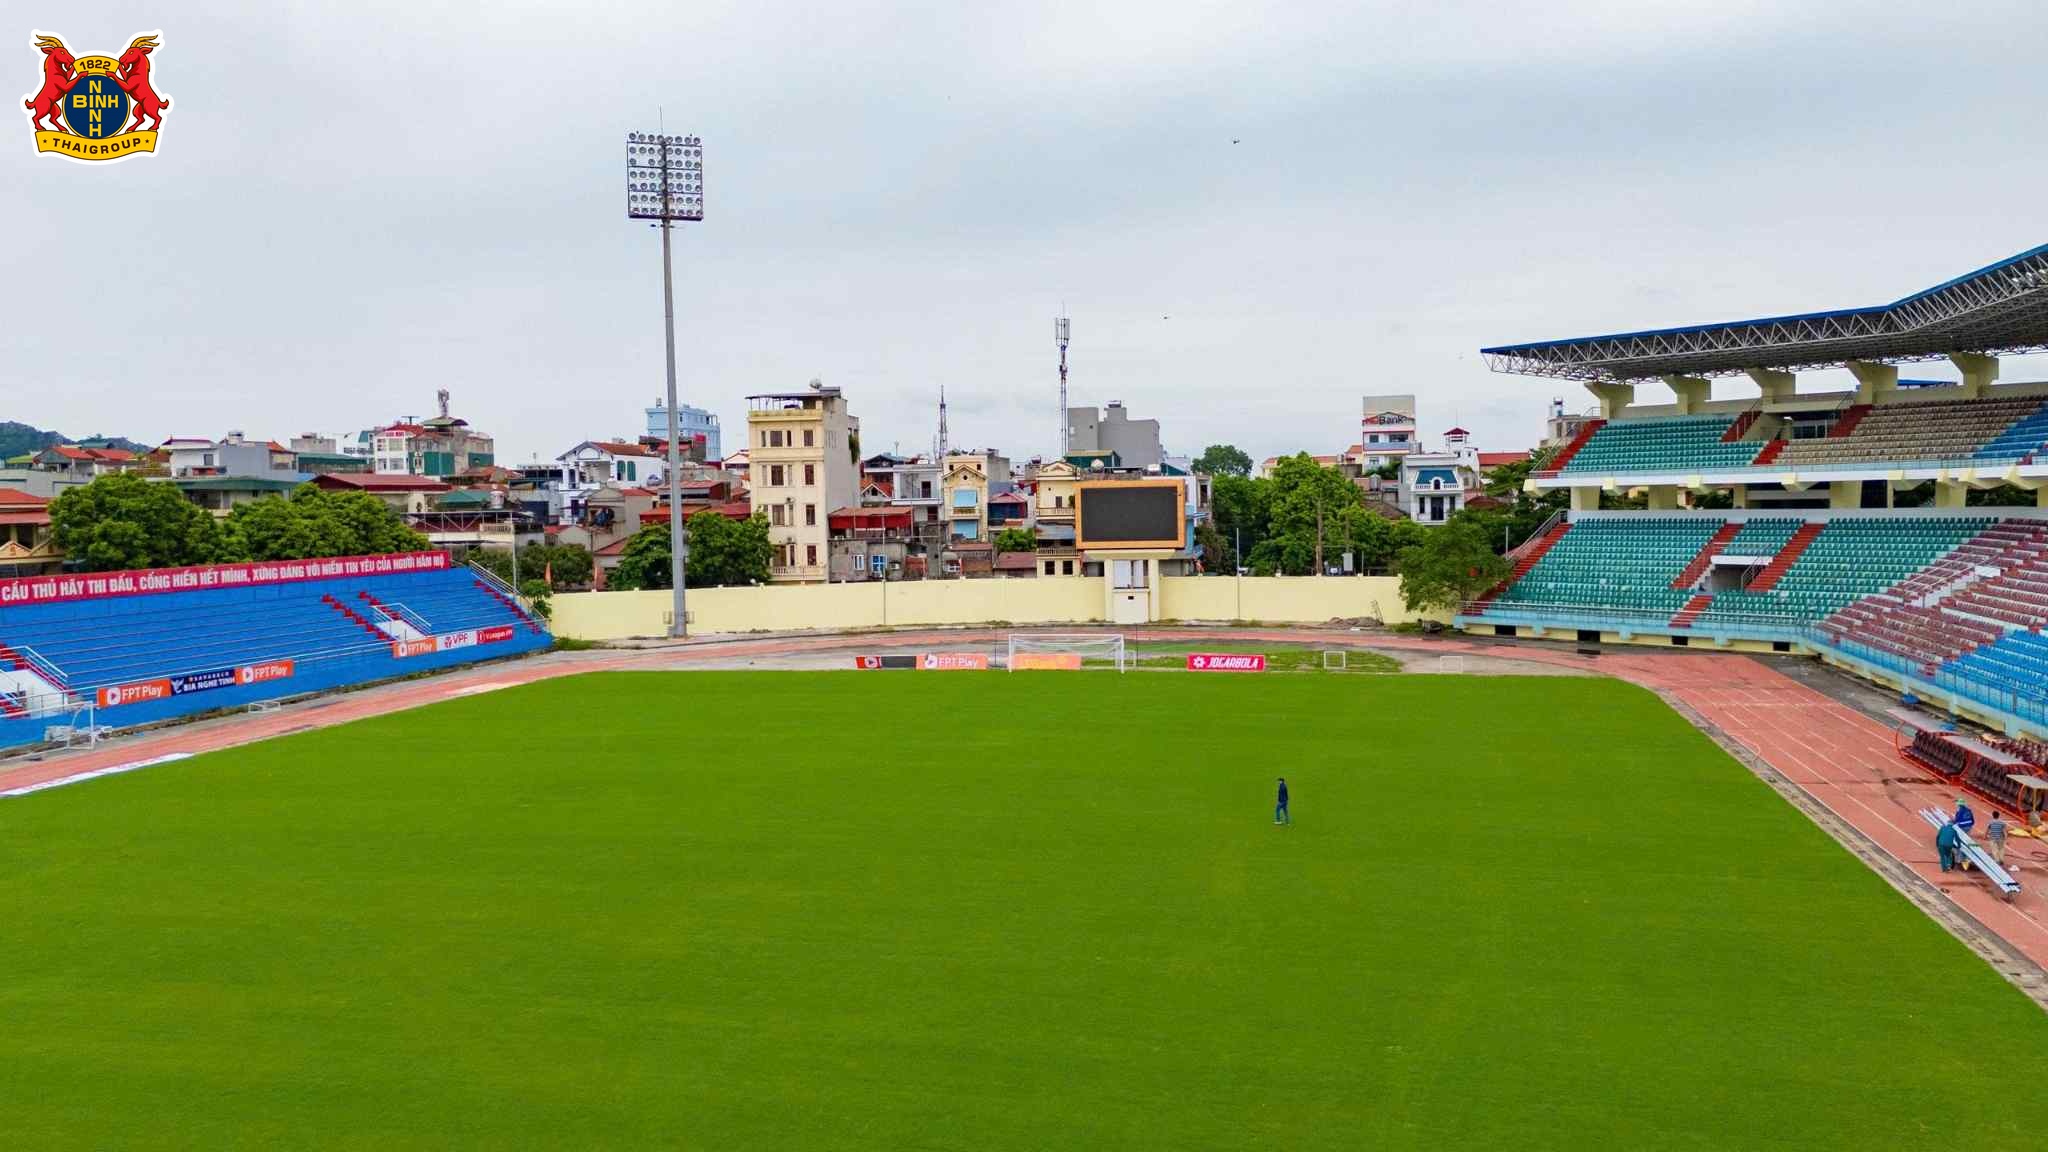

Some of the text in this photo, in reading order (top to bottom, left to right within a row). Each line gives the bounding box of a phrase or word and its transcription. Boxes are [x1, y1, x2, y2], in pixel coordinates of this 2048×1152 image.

[32, 578, 57, 599] THỦ
[60, 578, 84, 596] HÃY
[88, 579, 107, 594] THI
[200, 568, 219, 584] HẾT
[940, 656, 977, 668] FPT Play
[254, 665, 288, 679] FPT Play
[122, 685, 162, 700] FPT Play
